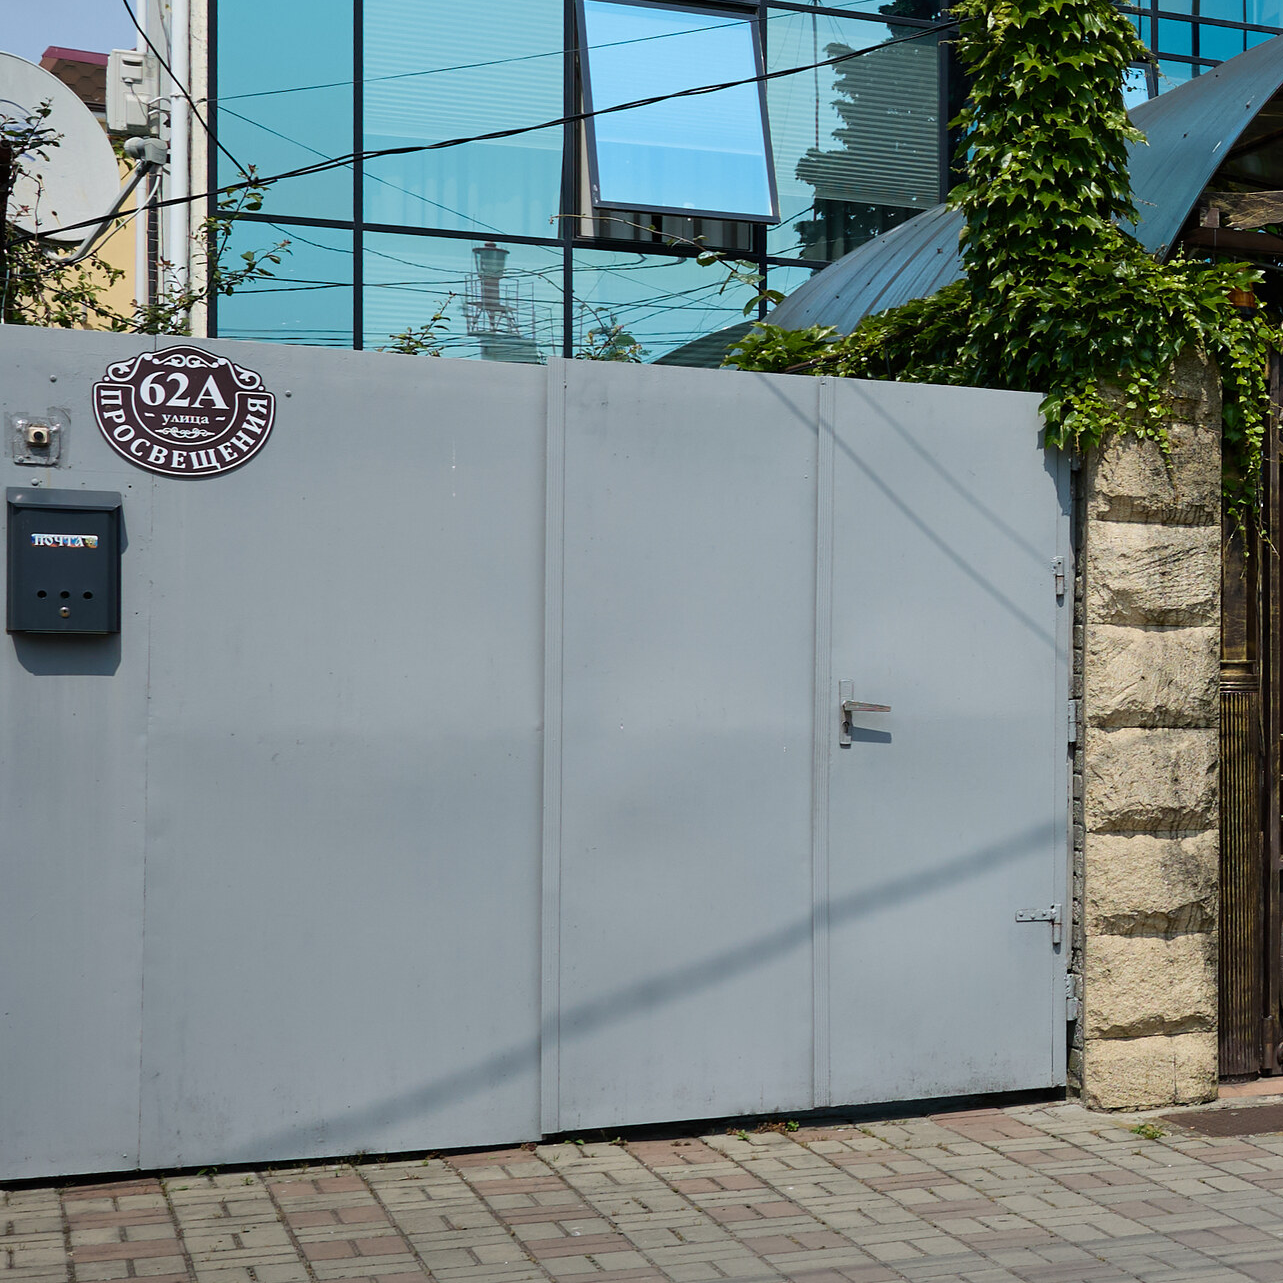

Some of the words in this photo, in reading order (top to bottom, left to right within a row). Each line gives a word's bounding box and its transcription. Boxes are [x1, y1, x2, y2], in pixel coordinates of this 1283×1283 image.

[140, 371, 230, 410] 62А
[100, 389, 268, 470] ПРОСВЕЩЕНИЯ
[162, 413, 209, 425] улица
[34, 535, 85, 547] ПОЧТА
